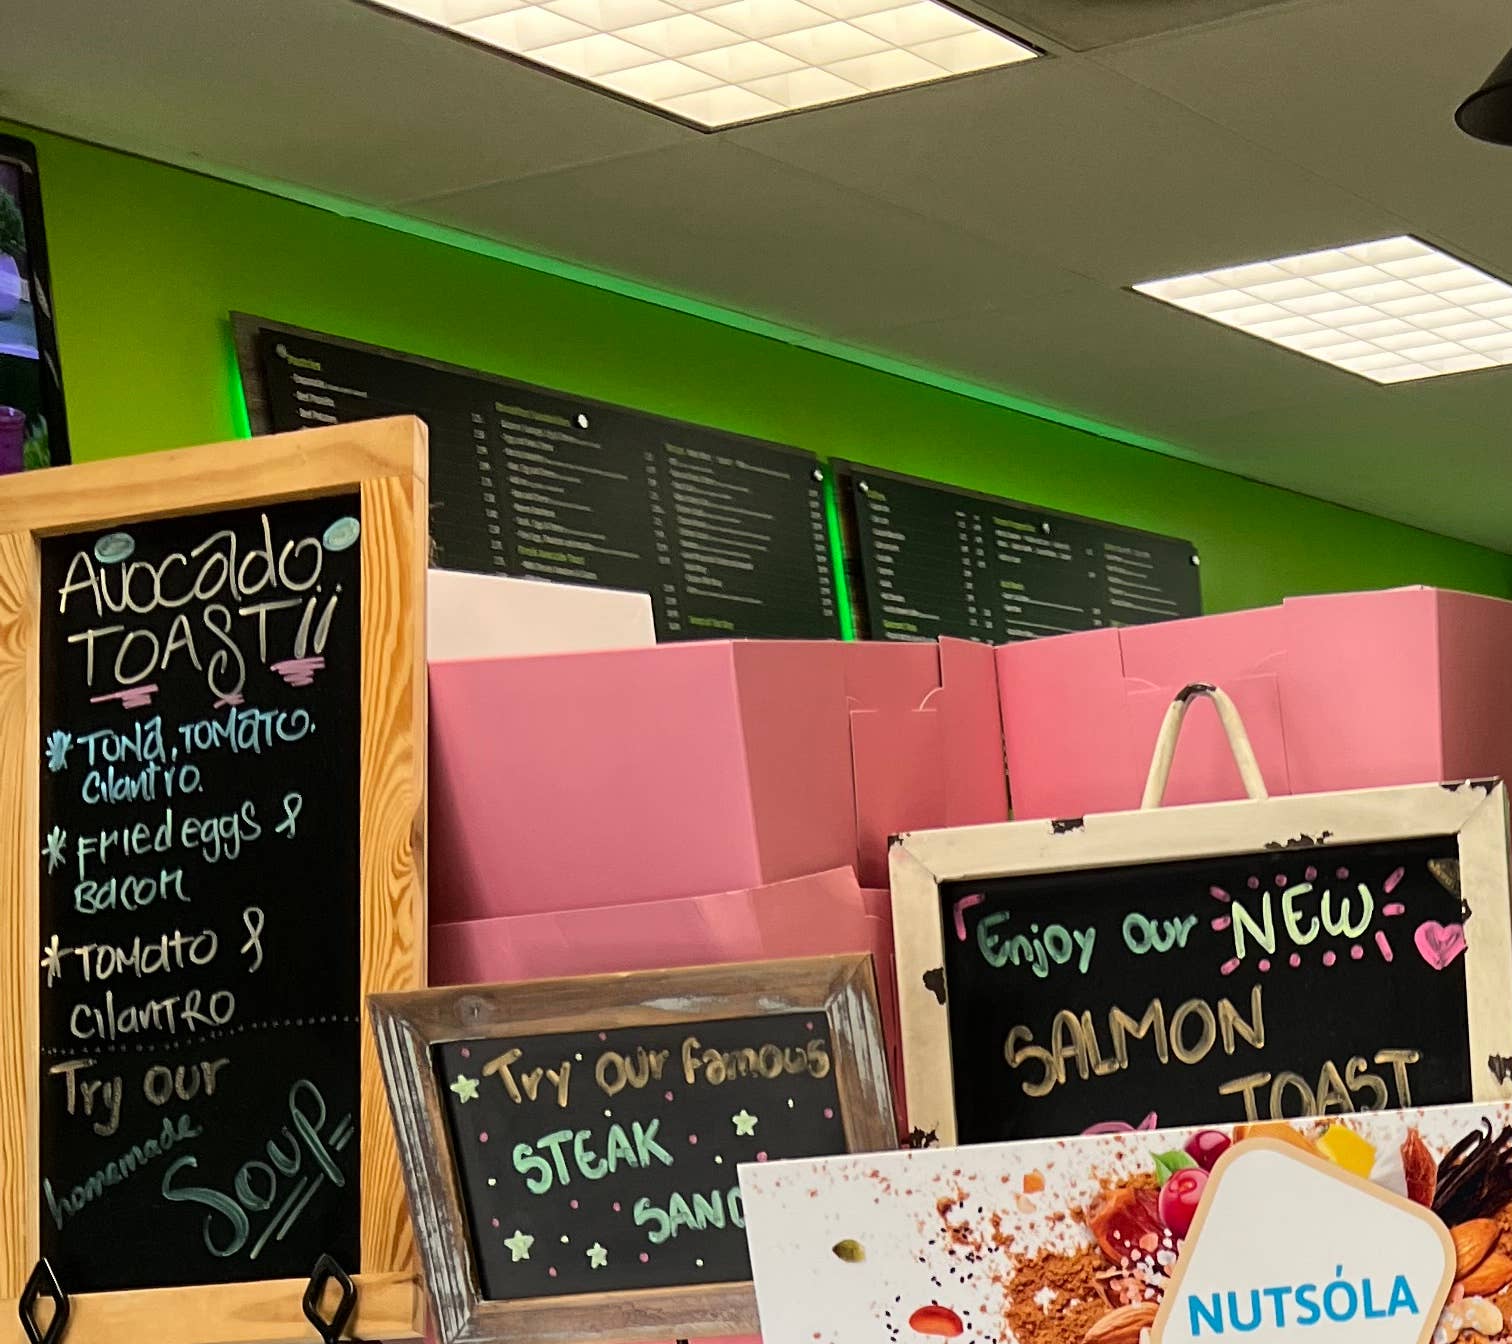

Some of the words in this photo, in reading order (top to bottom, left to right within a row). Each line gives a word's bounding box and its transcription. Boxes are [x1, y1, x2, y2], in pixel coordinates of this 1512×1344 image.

[976, 911, 1096, 978] Enjoy
[1122, 913, 1196, 955] Our
[1231, 883, 1375, 960] NEW
[483, 1048, 571, 1108] Try
[1004, 983, 1266, 1098] SALMON
[49, 1059, 124, 1137] Try
[1219, 1049, 1420, 1123] TOAST
[44, 1114, 202, 1230] homemade
[512, 1118, 674, 1194] STEAK
[1187, 1264, 1420, 1341] NUTSÓLA
